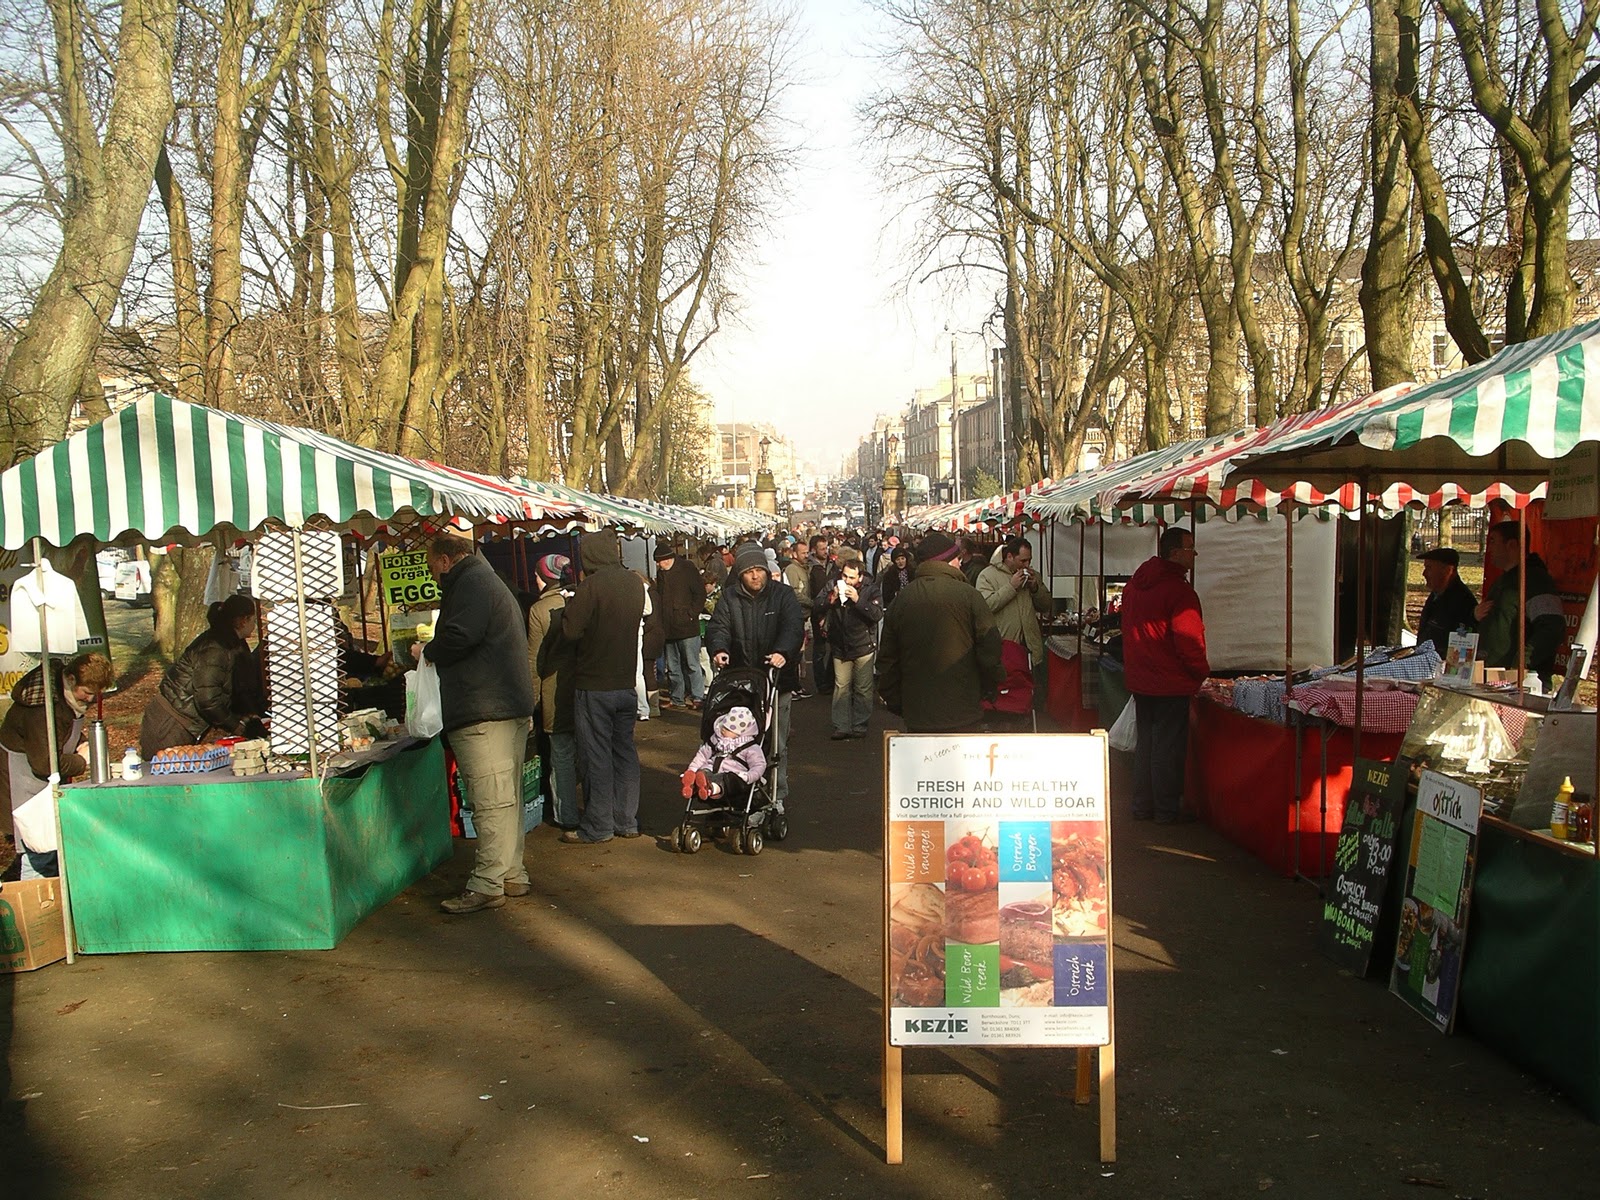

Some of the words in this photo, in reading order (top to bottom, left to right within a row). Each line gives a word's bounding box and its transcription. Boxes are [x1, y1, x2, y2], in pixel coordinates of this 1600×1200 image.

[384, 555, 412, 568] FOR
[934, 748, 950, 758] seen
[917, 781, 965, 792] FRESH
[974, 781, 1004, 792] AND
[1011, 781, 1078, 792] HEALTHY
[900, 797, 964, 809] OSTRICH
[972, 798, 1002, 808] AND
[1010, 798, 1046, 808] WILD
[1054, 798, 1096, 808] BOAR
[904, 824, 916, 849] Boar
[1008, 832, 1022, 872] Ostrich
[1026, 834, 1042, 872] Burger
[902, 852, 915, 880] Wild
[960, 948, 972, 974] Boar
[1066, 954, 1079, 996] Ostrich
[958, 976, 972, 1004] Wild
[905, 1019, 968, 1033] KEZIE
